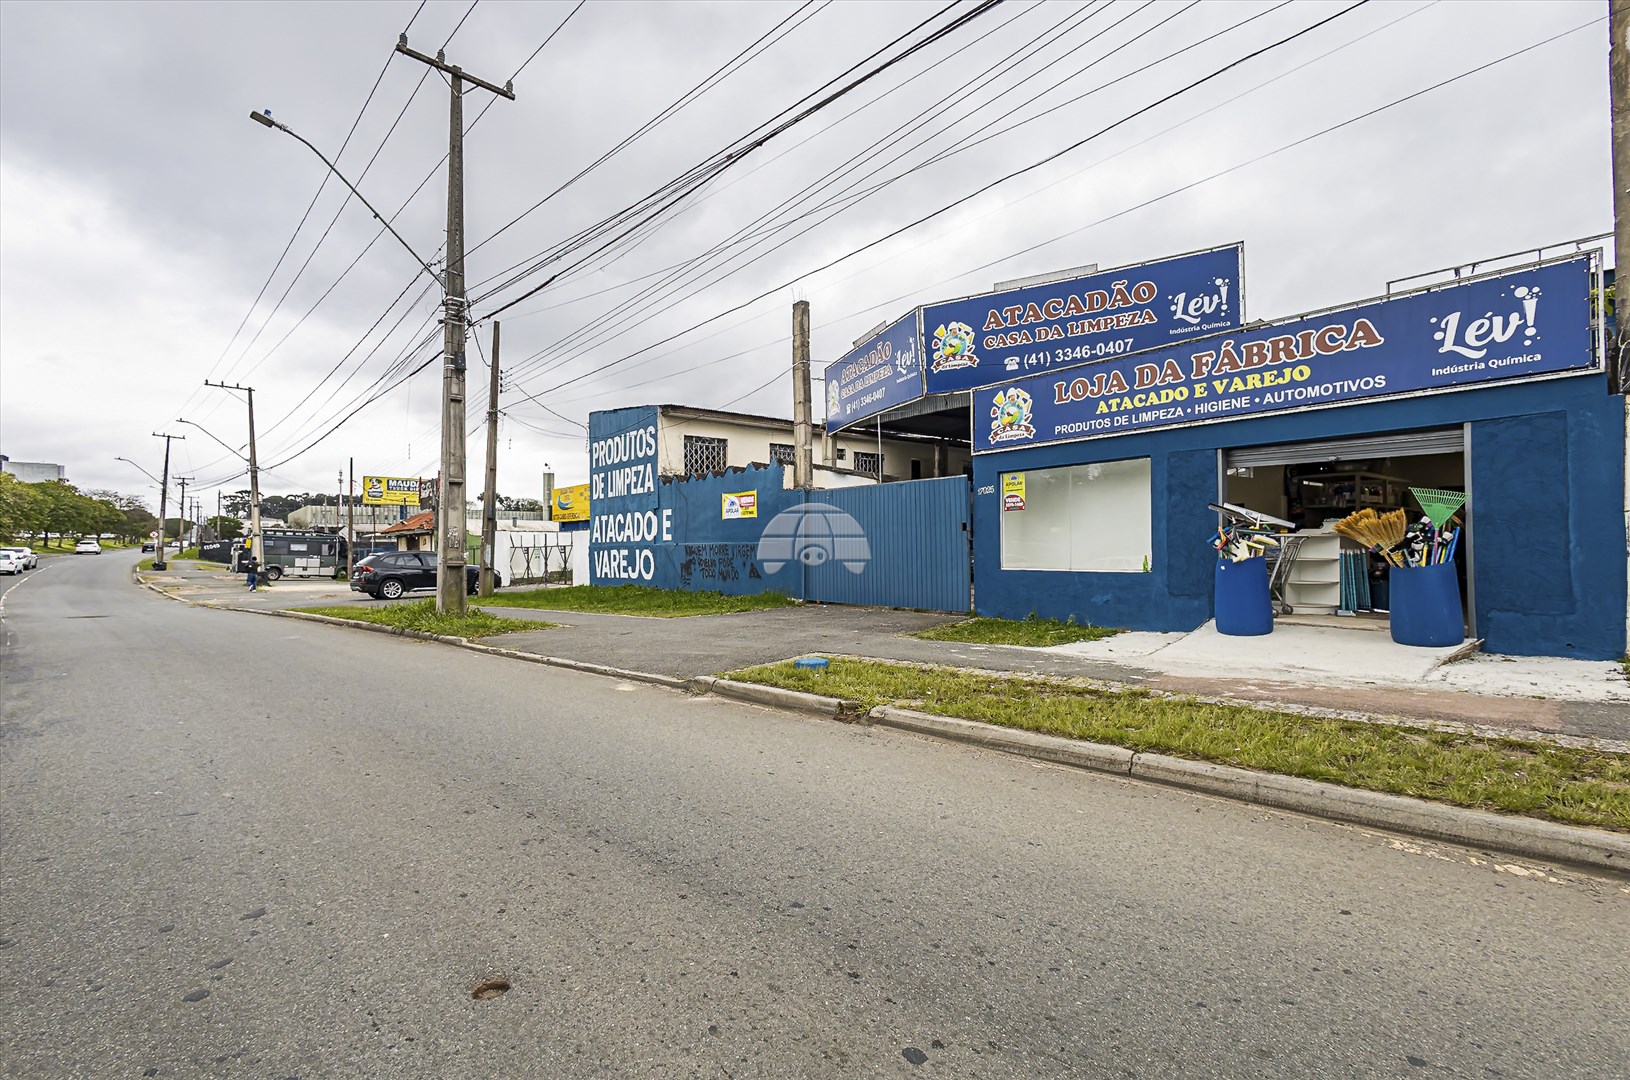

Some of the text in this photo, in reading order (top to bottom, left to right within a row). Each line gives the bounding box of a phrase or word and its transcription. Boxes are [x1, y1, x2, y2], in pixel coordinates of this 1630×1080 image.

[983, 280, 1157, 331] ATACADÃO
[984, 308, 1157, 350] CASA DA LIMPEZA
[1169, 321, 1231, 335] Indústria Química
[841, 341, 892, 386] ATACADÃO
[1024, 338, 1134, 369] (41) 3346-0407
[1054, 318, 1385, 405] LOJA DA FÁBRICA
[1431, 353, 1542, 376] Indústria Química
[1054, 375, 1386, 435] PRODUTOS DE LIMPEZA HIGIENE AUTOMOTIVOS
[1096, 365, 1311, 415] ATACADO E VAREJO
[592, 425, 656, 468] PRODUTOS
[592, 472, 605, 500] DE
[607, 463, 654, 498] LIMPEZA
[592, 508, 672, 543] ATACADO E
[594, 549, 655, 580] VAREJO
